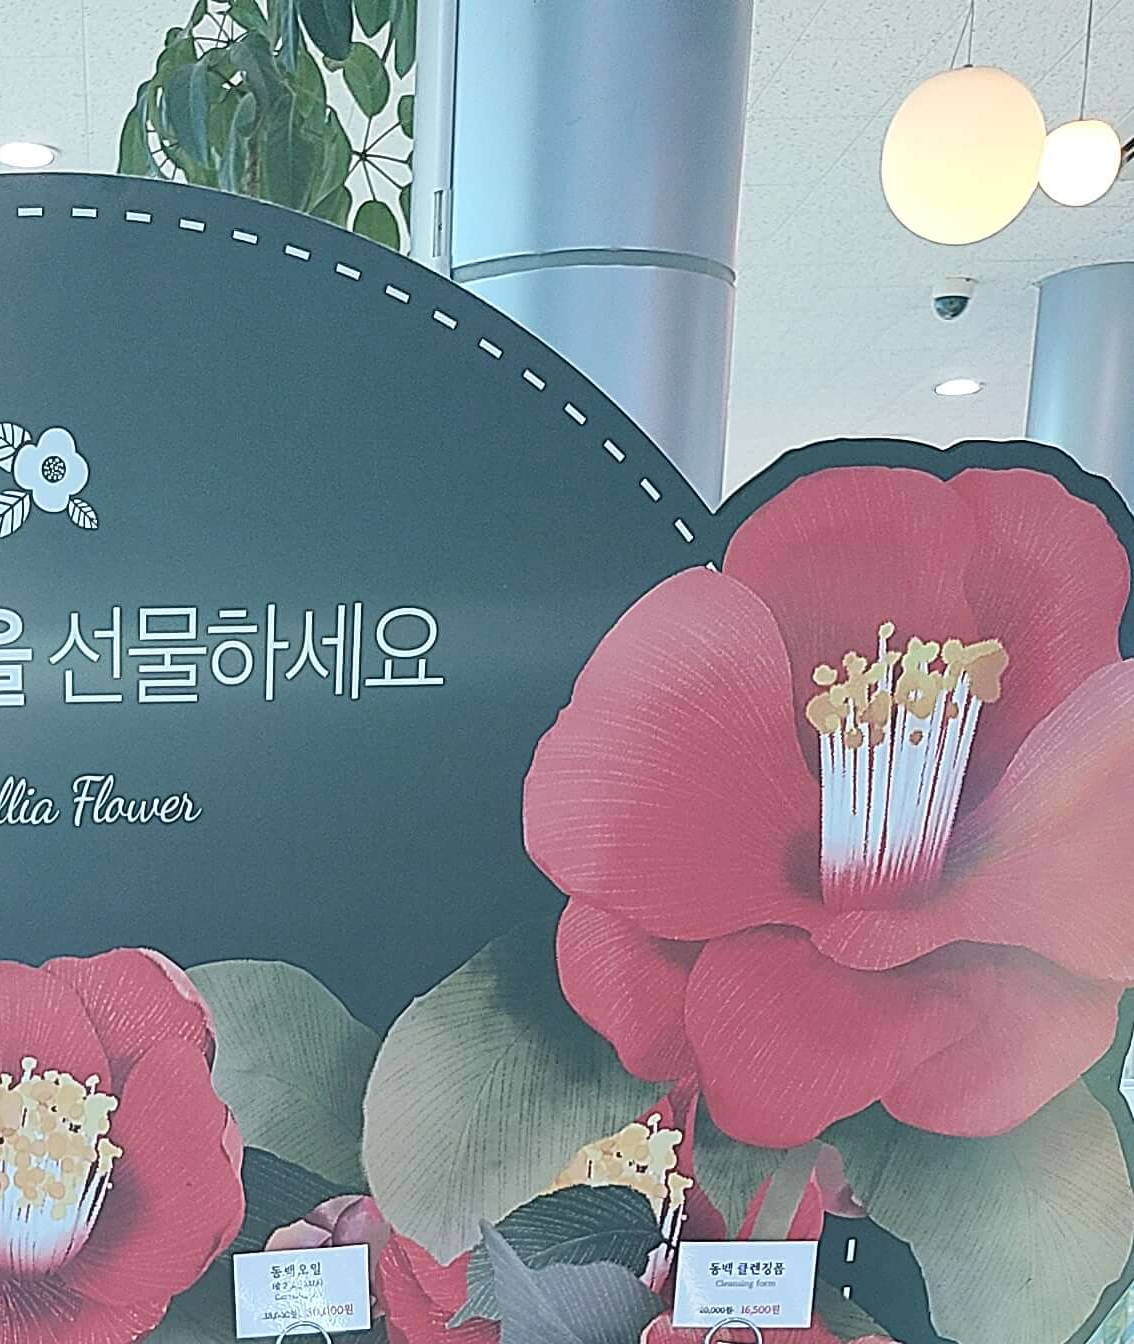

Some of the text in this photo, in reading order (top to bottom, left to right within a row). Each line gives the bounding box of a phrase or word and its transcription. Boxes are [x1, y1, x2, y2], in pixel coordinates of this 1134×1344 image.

[49, 602, 444, 703] 선물하세요
[71, 773, 202, 827] Flower
[709, 1262, 785, 1276] 동백 클렌징폼
[741, 1304, 780, 1316] 16,500원
